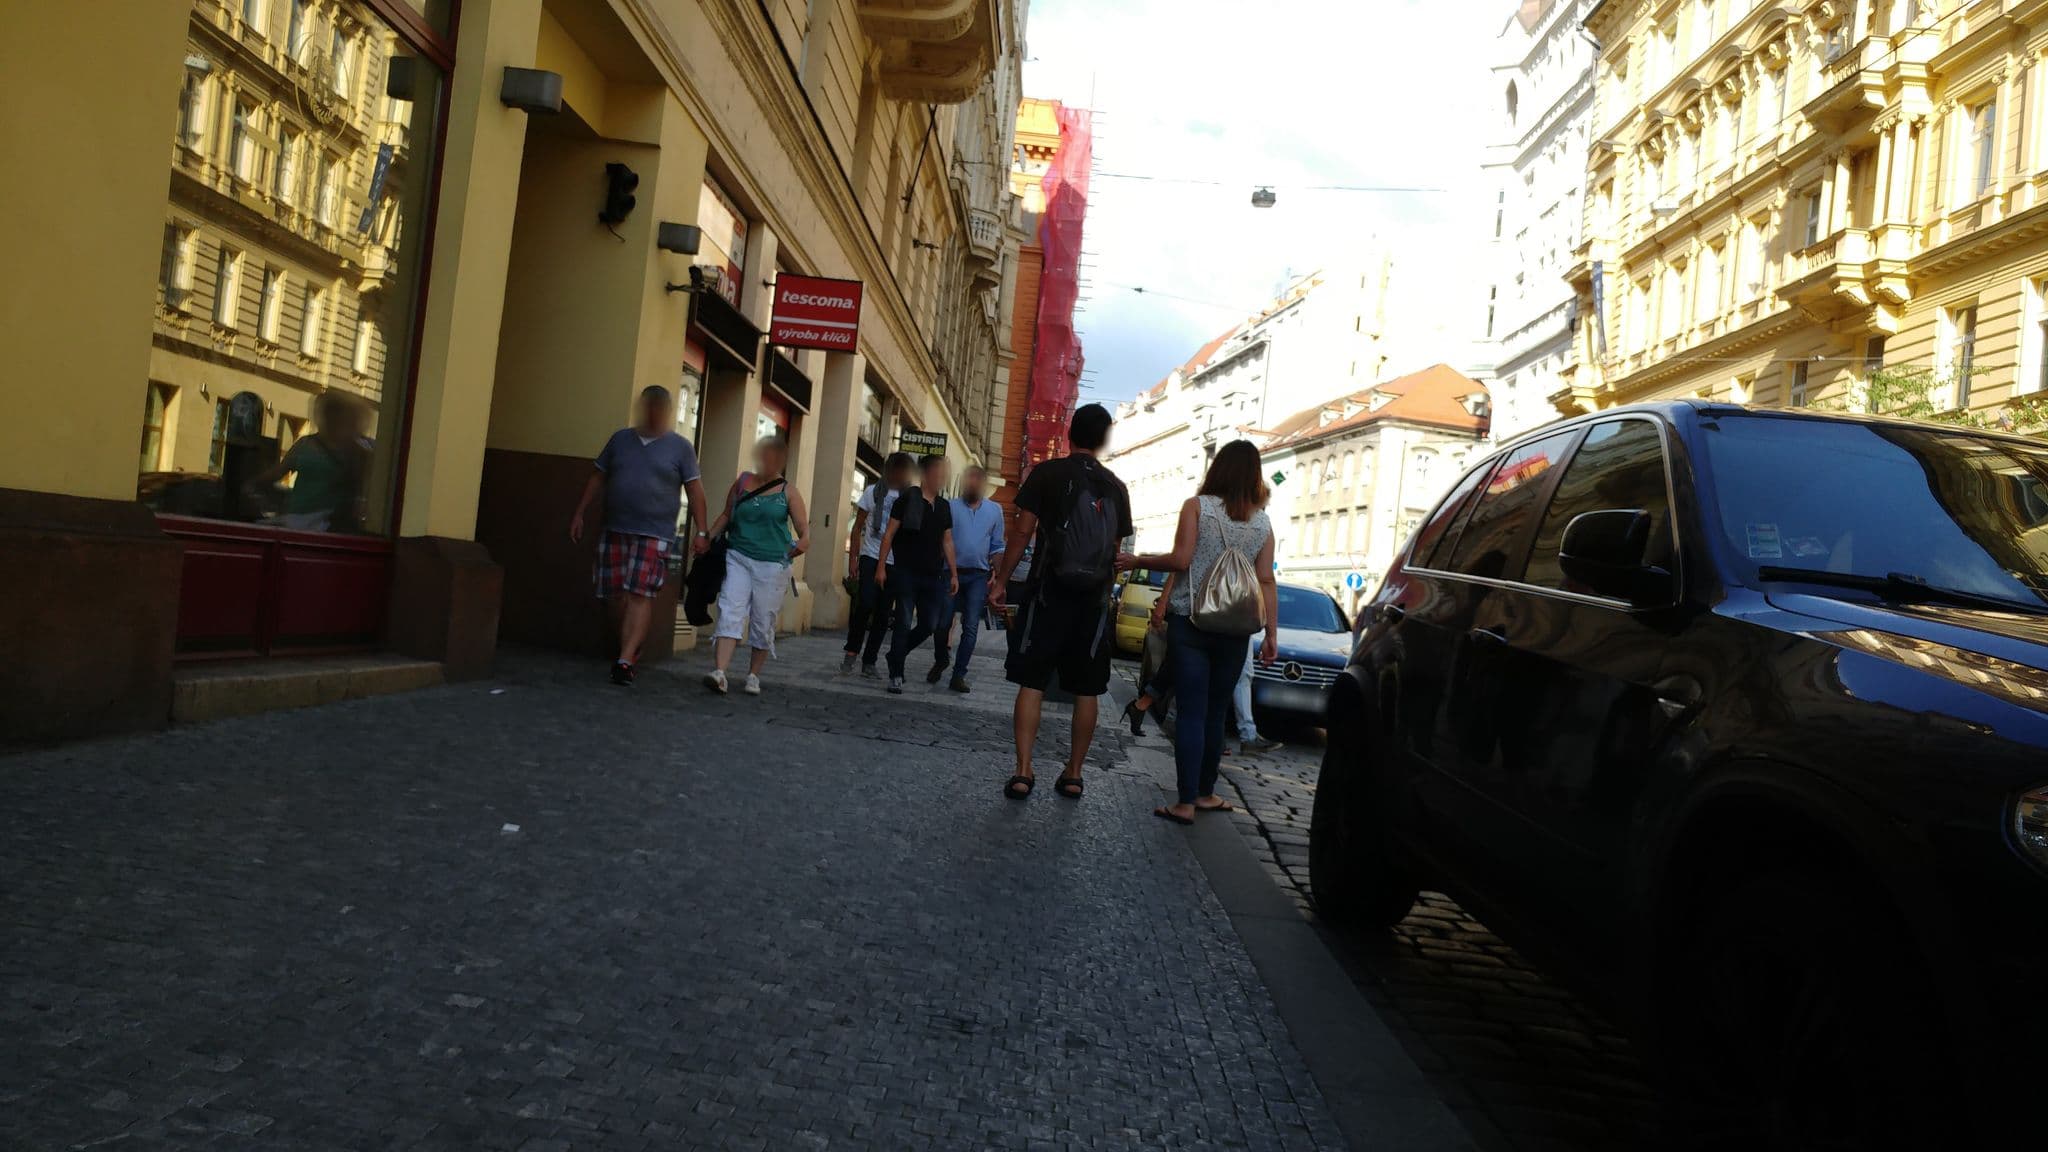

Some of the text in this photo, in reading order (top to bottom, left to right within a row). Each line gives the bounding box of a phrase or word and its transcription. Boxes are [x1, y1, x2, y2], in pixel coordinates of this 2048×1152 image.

[782, 290, 855, 309] tescoma.
[778, 328, 850, 343] výroba klíčů
